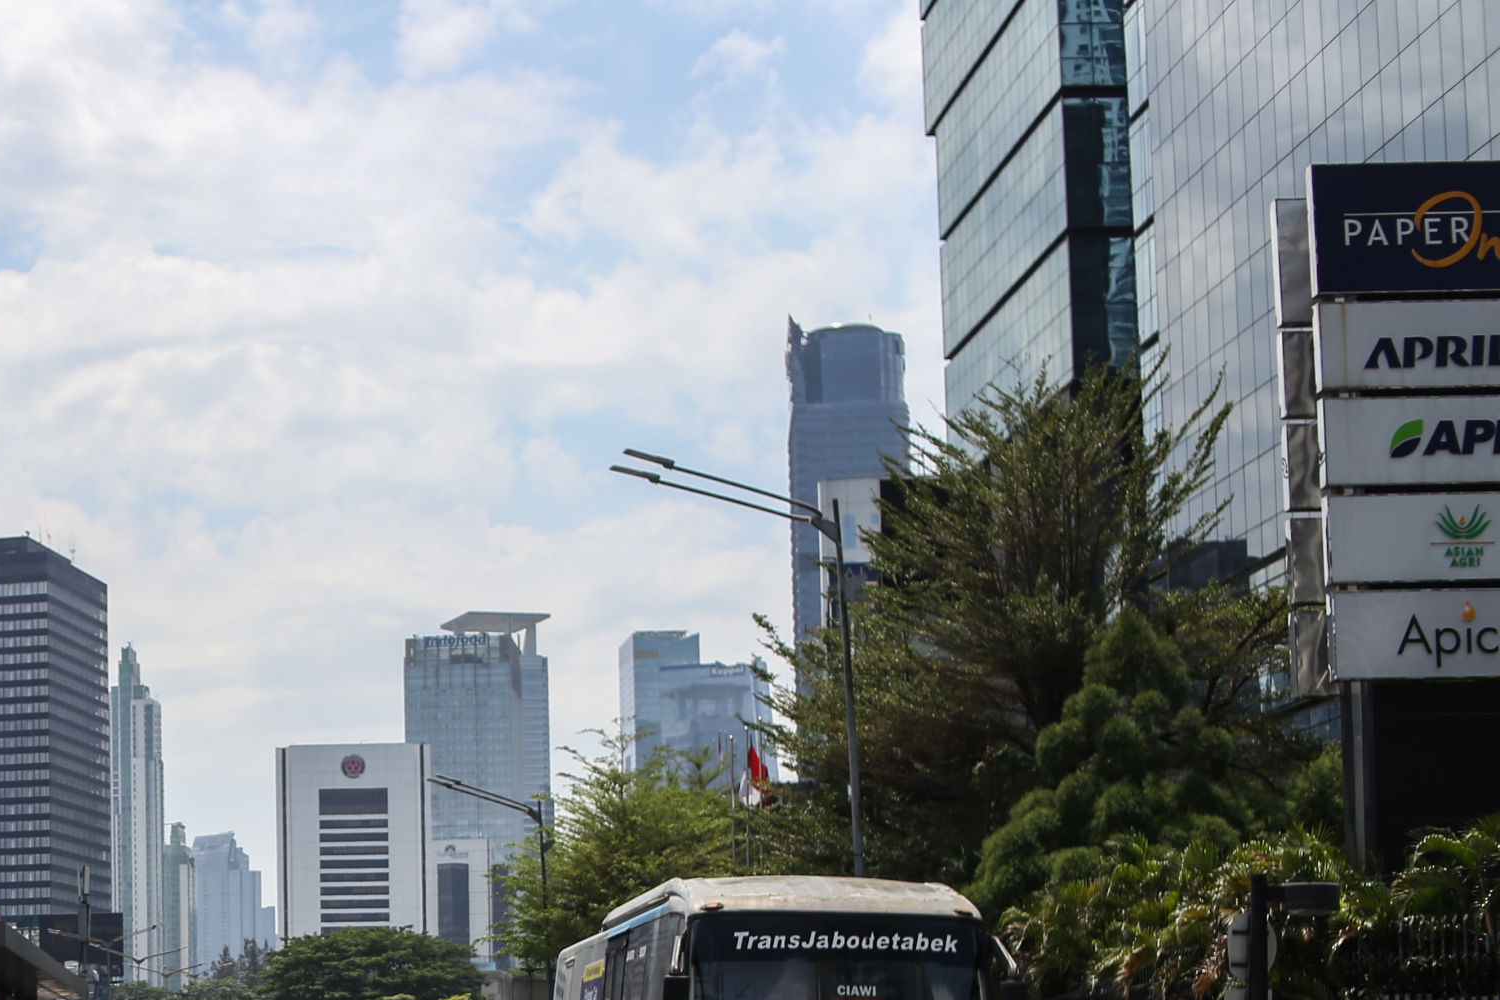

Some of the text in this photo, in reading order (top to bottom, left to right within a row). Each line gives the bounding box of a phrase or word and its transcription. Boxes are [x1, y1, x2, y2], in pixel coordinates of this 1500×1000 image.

[1344, 216, 1469, 246] PAPER
[1444, 547, 1483, 557] ASIAN
[1450, 557, 1480, 567] AGRI
[733, 930, 958, 953] TransJabodetabek
[837, 984, 877, 997] CIAWI
